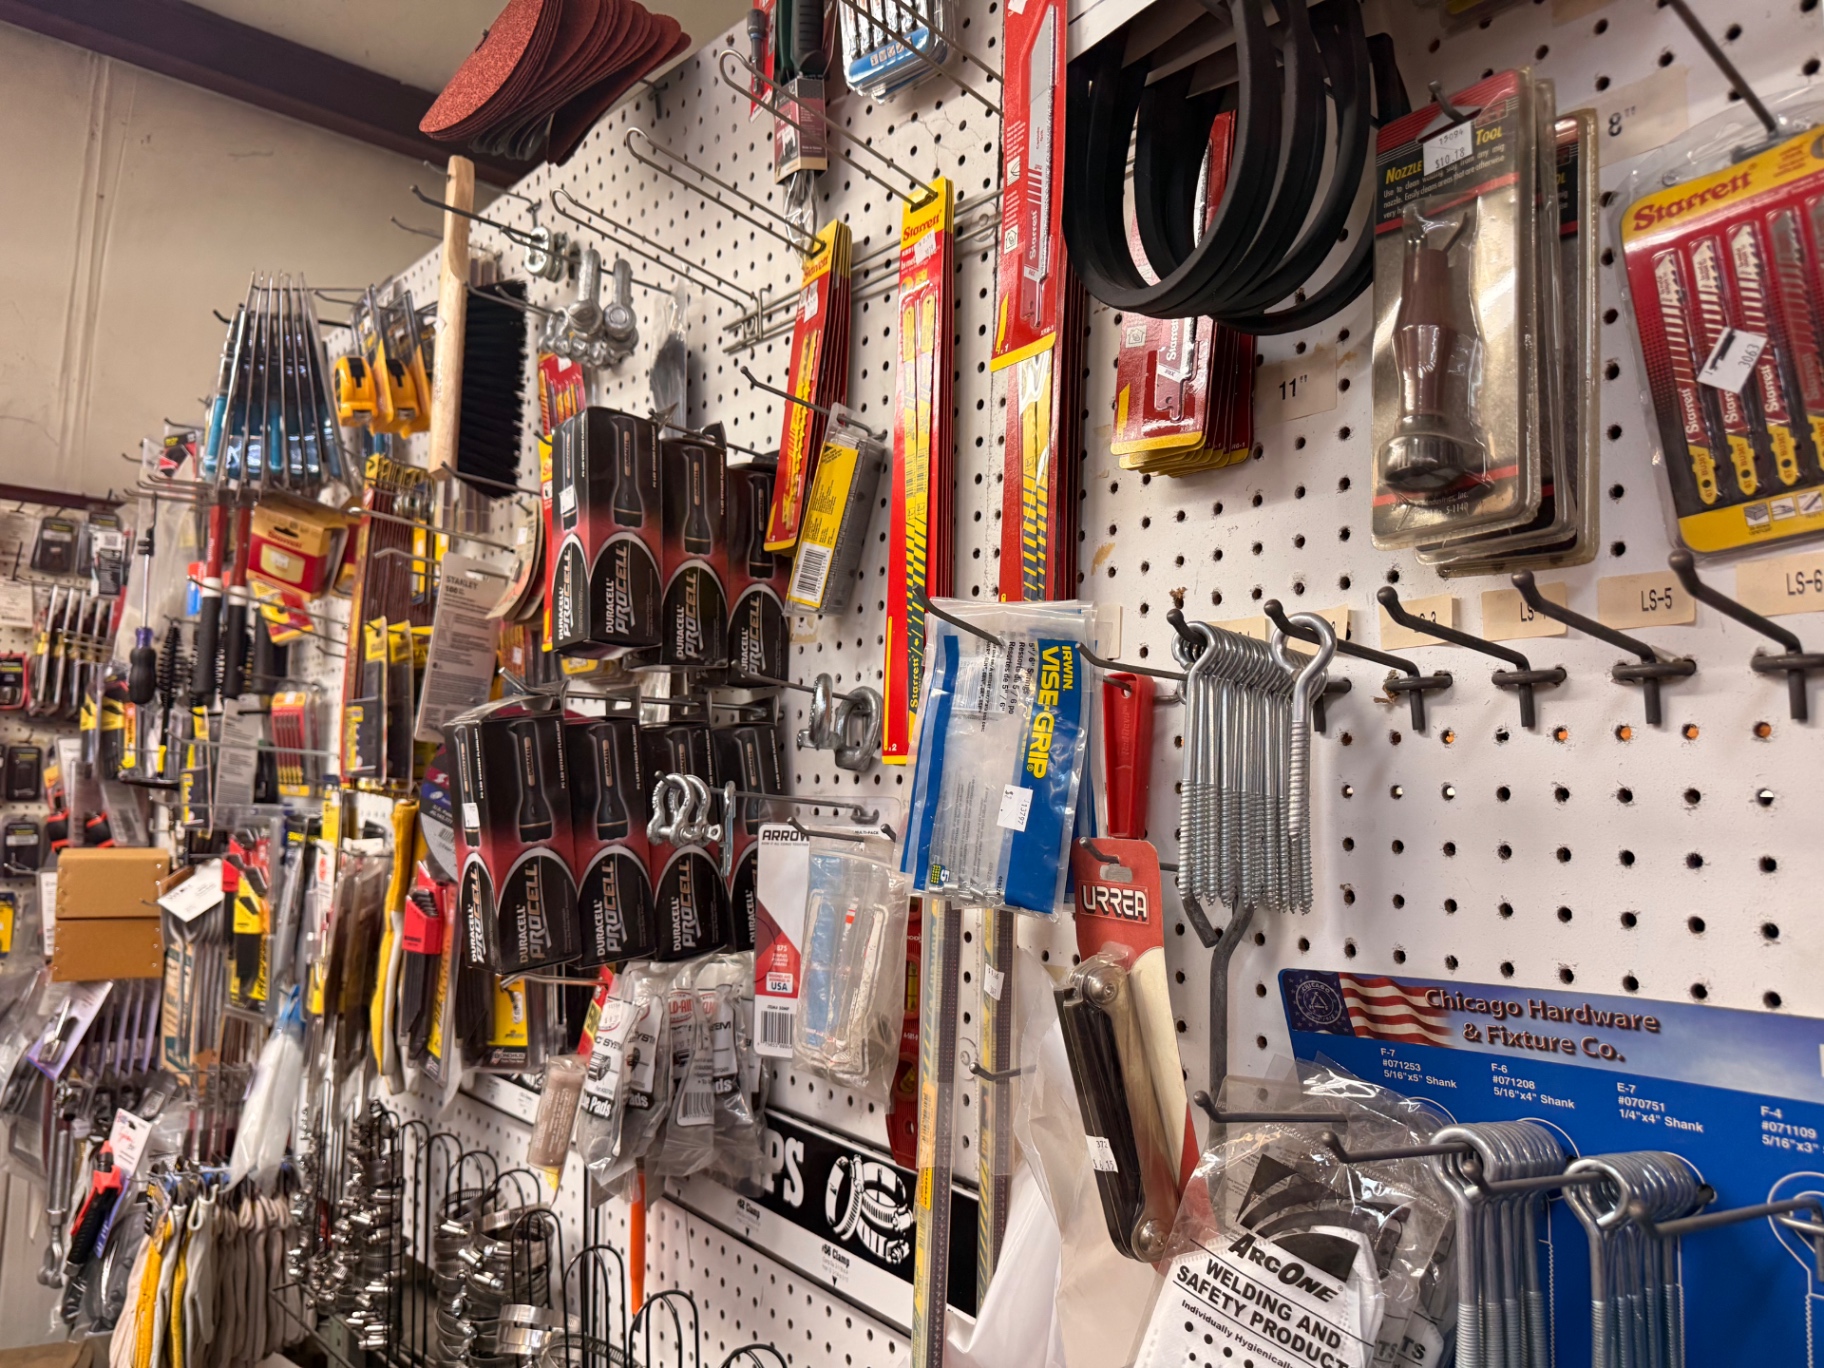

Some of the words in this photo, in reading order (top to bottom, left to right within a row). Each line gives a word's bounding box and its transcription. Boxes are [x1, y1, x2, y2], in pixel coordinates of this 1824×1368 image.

[1434, 147, 1466, 169] $10.18
[1633, 171, 1753, 232] Starrett
[903, 214, 939, 241] Starrett
[1029, 209, 1038, 261] Starrett
[562, 549, 573, 637] PROCELL
[615, 545, 628, 636] PROCELL
[1640, 587, 1674, 613] LS-5
[1785, 568, 1824, 597] LS-6
[605, 577, 614, 634] DURACELL
[684, 571, 698, 660] PROCELL
[676, 604, 684, 658] DURACELL
[911, 656, 919, 708] Starrett
[1033, 645, 1060, 779] VISE-GRIP
[470, 867, 486, 964] PROCELL
[525, 863, 546, 960] PROCELL
[602, 860, 622, 952] PROCELL
[672, 897, 681, 951] DURACELL
[679, 858, 697, 948] PROCELL
[1081, 885, 1149, 921] URREA
[468, 903, 478, 963] DURACELL
[516, 905, 528, 964] DURACELL
[594, 899, 606, 957] DURACELL
[771, 982, 788, 991] USA
[1425, 988, 1521, 1018] Chicago
[1528, 998, 1661, 1031] Hardware
[1380, 1048, 1396, 1057] F-7
[1463, 1022, 1482, 1043] &
[1486, 1024, 1576, 1055] Fixture
[1581, 1036, 1626, 1061] Co.
[1382, 1059, 1421, 1072] #071253
[1426, 1076, 1457, 1089] Shank
[1491, 1063, 1508, 1074] F-6
[1493, 1075, 1535, 1090] #071208
[1541, 1095, 1575, 1109] Shank
[1617, 1082, 1636, 1094] E-7
[1619, 1096, 1666, 1112] #070751
[1665, 1116, 1704, 1133] Shank
[1760, 1105, 1782, 1119] F-4
[1761, 1121, 1817, 1139] #071109
[1177, 1265, 1247, 1318] SAFETY
[1206, 1258, 1292, 1321] WELDING
[1296, 1315, 1341, 1349] AND
[1182, 1299, 1233, 1338] Individually
